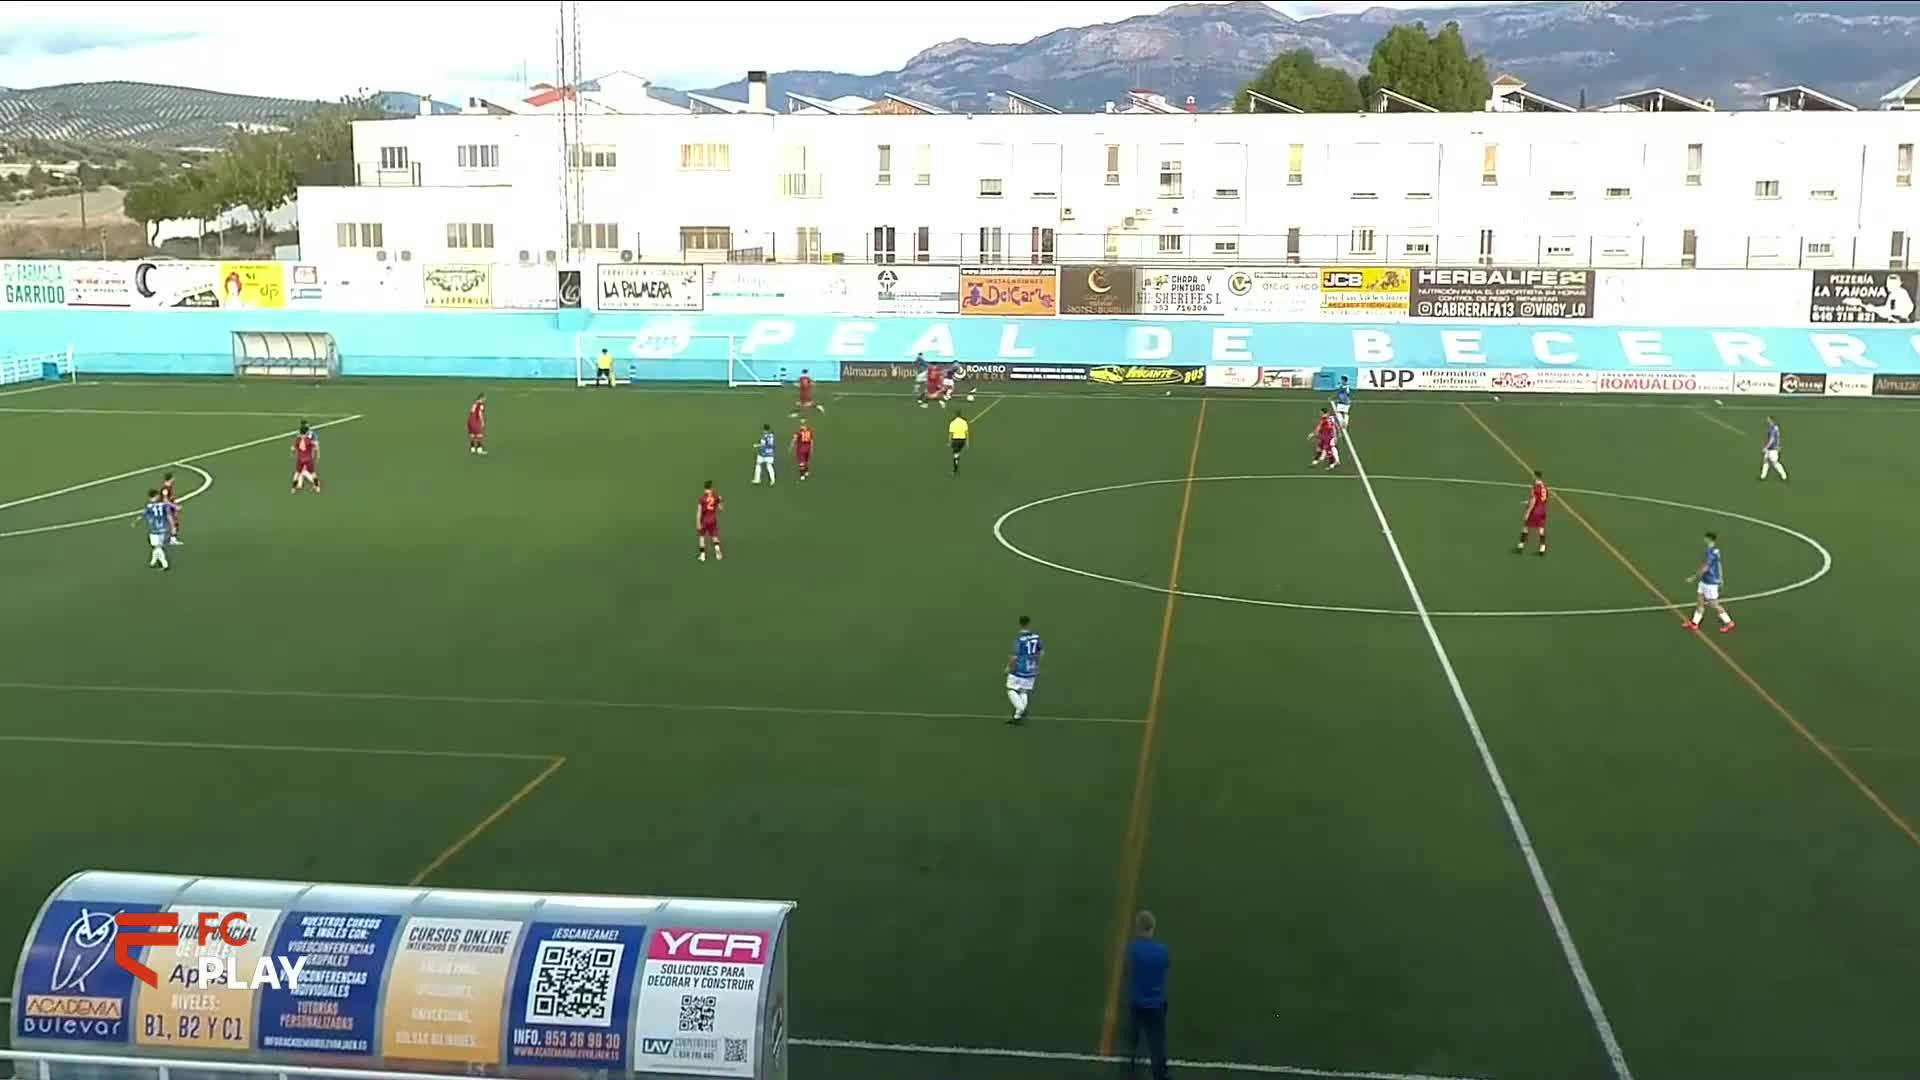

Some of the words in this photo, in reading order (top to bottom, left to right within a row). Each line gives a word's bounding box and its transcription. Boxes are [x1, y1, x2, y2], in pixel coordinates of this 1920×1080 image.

[1171, 275, 1198, 284] CHAPA
[1323, 272, 1361, 287] JCB
[6, 284, 65, 304] GARRIDO
[604, 281, 619, 298] LA
[621, 280, 672, 299] PALMERA
[1171, 284, 1206, 292] PINTURA
[1814, 286, 1830, 297] LA
[1834, 286, 1888, 297] TAHONA
[738, 319, 1036, 359] PEAL
[1132, 326, 1253, 361] DE
[842, 365, 887, 377] Almazara
[966, 365, 1006, 373] ROMERO
[1183, 367, 1204, 383] BUS
[1368, 370, 1415, 388] APP
[1600, 378, 1697, 390] ROMUALDO
[151, 503, 164, 516] 11
[706, 496, 715, 511] 2
[1026, 639, 1038, 655] 17
[301, 916, 346, 929] NUESTROS
[346, 918, 382, 930] CURSOS
[302, 926, 314, 938] DE
[408, 926, 461, 944] CURSOS
[463, 928, 511, 945] ONLINE
[287, 940, 376, 956] VIDEOCONFERENCIAS
[661, 930, 762, 959] YCR
[660, 963, 718, 977] SOLUCIONES
[720, 966, 745, 978] PARA
[647, 975, 691, 988] DECORAR
[693, 977, 699, 989] Y
[700, 977, 754, 991] CONSTRUIR
[28, 998, 121, 1017] ACADEMIA
[144, 1014, 172, 1039] B1,
[179, 1016, 200, 1038] B2
[208, 1018, 218, 1039] Y
[223, 1018, 243, 1040] C1
[514, 1029, 541, 1046] INFO.
[569, 1031, 584, 1048] 36
[605, 1033, 620, 1051] 30
[643, 1039, 672, 1054] LAV
